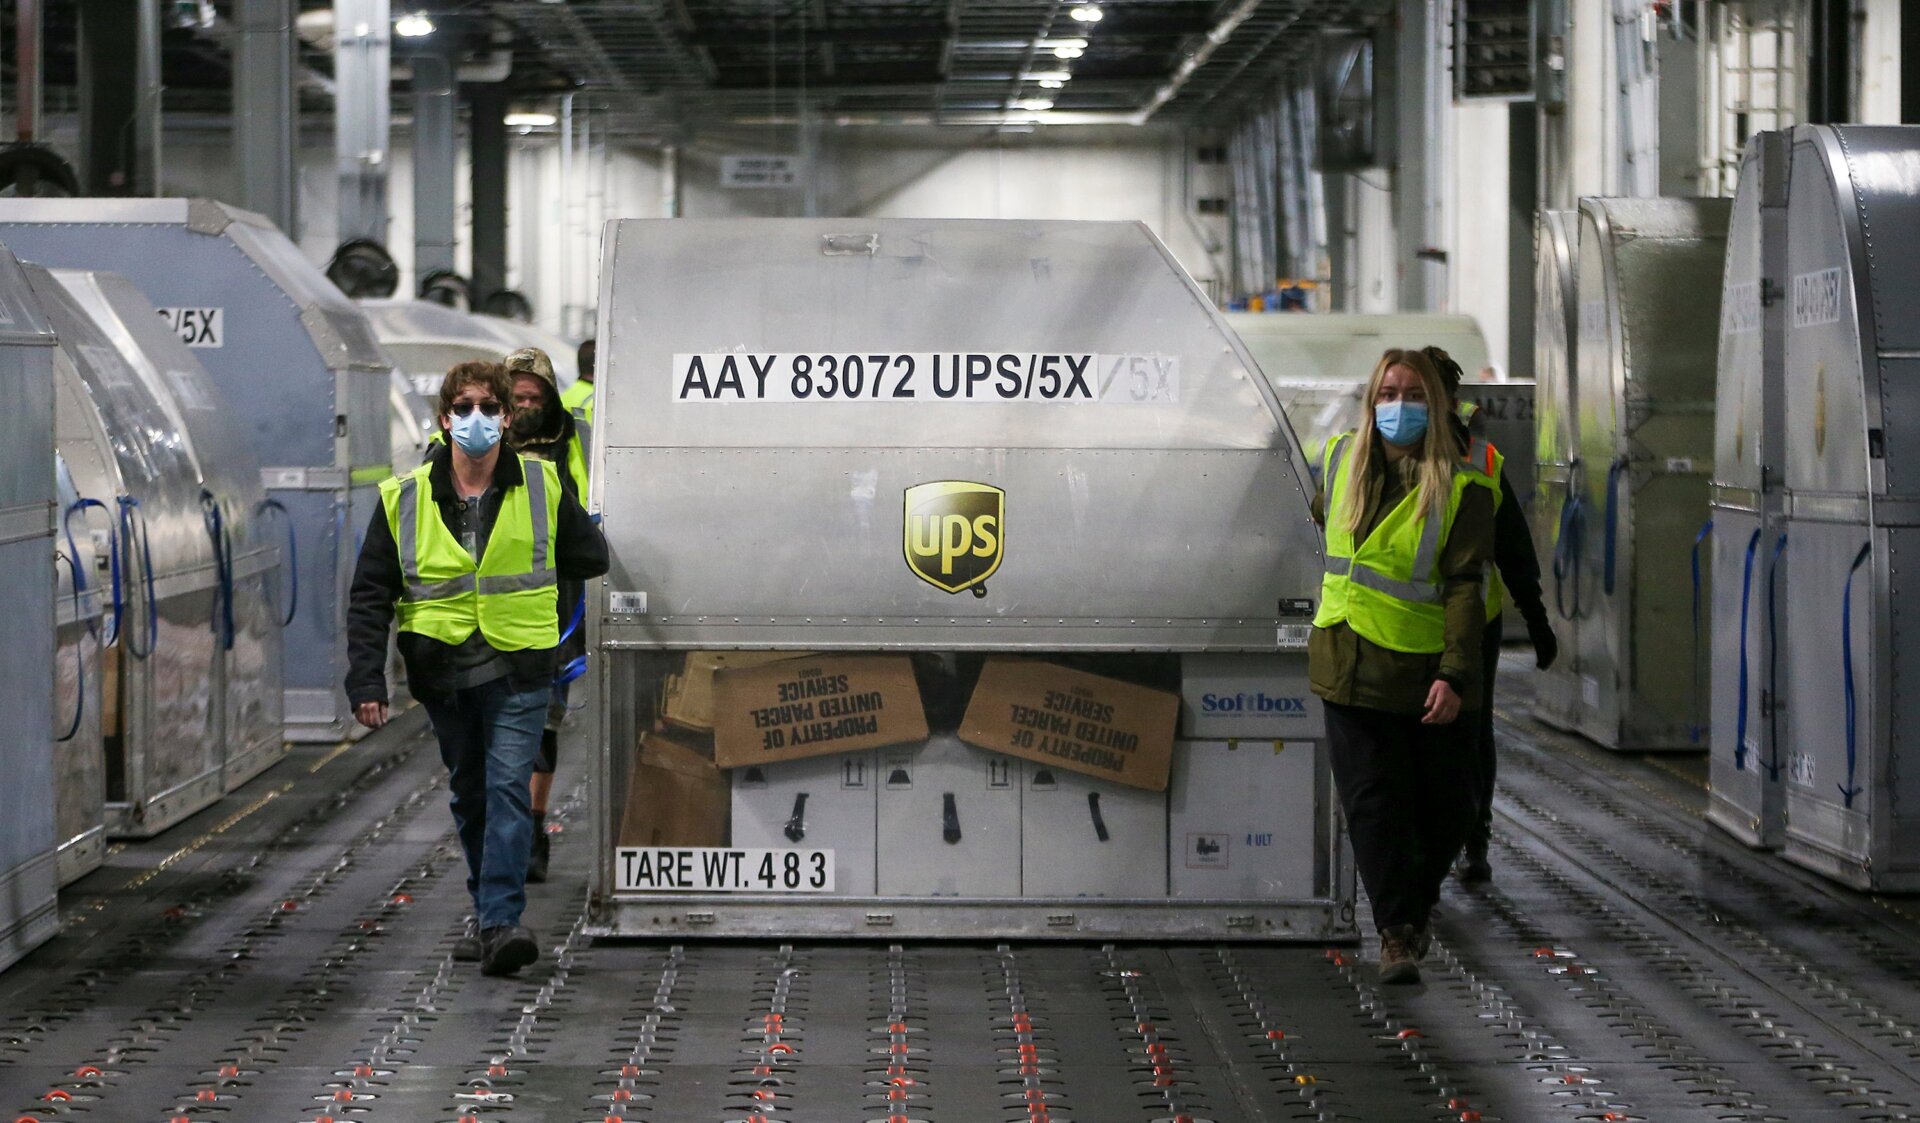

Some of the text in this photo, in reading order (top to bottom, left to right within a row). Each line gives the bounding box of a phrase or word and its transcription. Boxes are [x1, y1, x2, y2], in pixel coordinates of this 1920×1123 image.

[158, 309, 216, 344] /5X
[680, 354, 1093, 399] AAY 83072 UPS/5X
[912, 514, 997, 574] ups
[777, 674, 849, 702] SERVICE
[1202, 693, 1306, 712] Softbox
[750, 692, 883, 728] UNITED PARCEL
[1043, 690, 1115, 724] SERVICE
[763, 715, 878, 750] PROPERTY OF
[1011, 704, 1138, 753] UNITED PARCEL
[1011, 729, 1125, 772] PROPERTY OF
[621, 852, 693, 887] TARE
[703, 852, 748, 887] WT.
